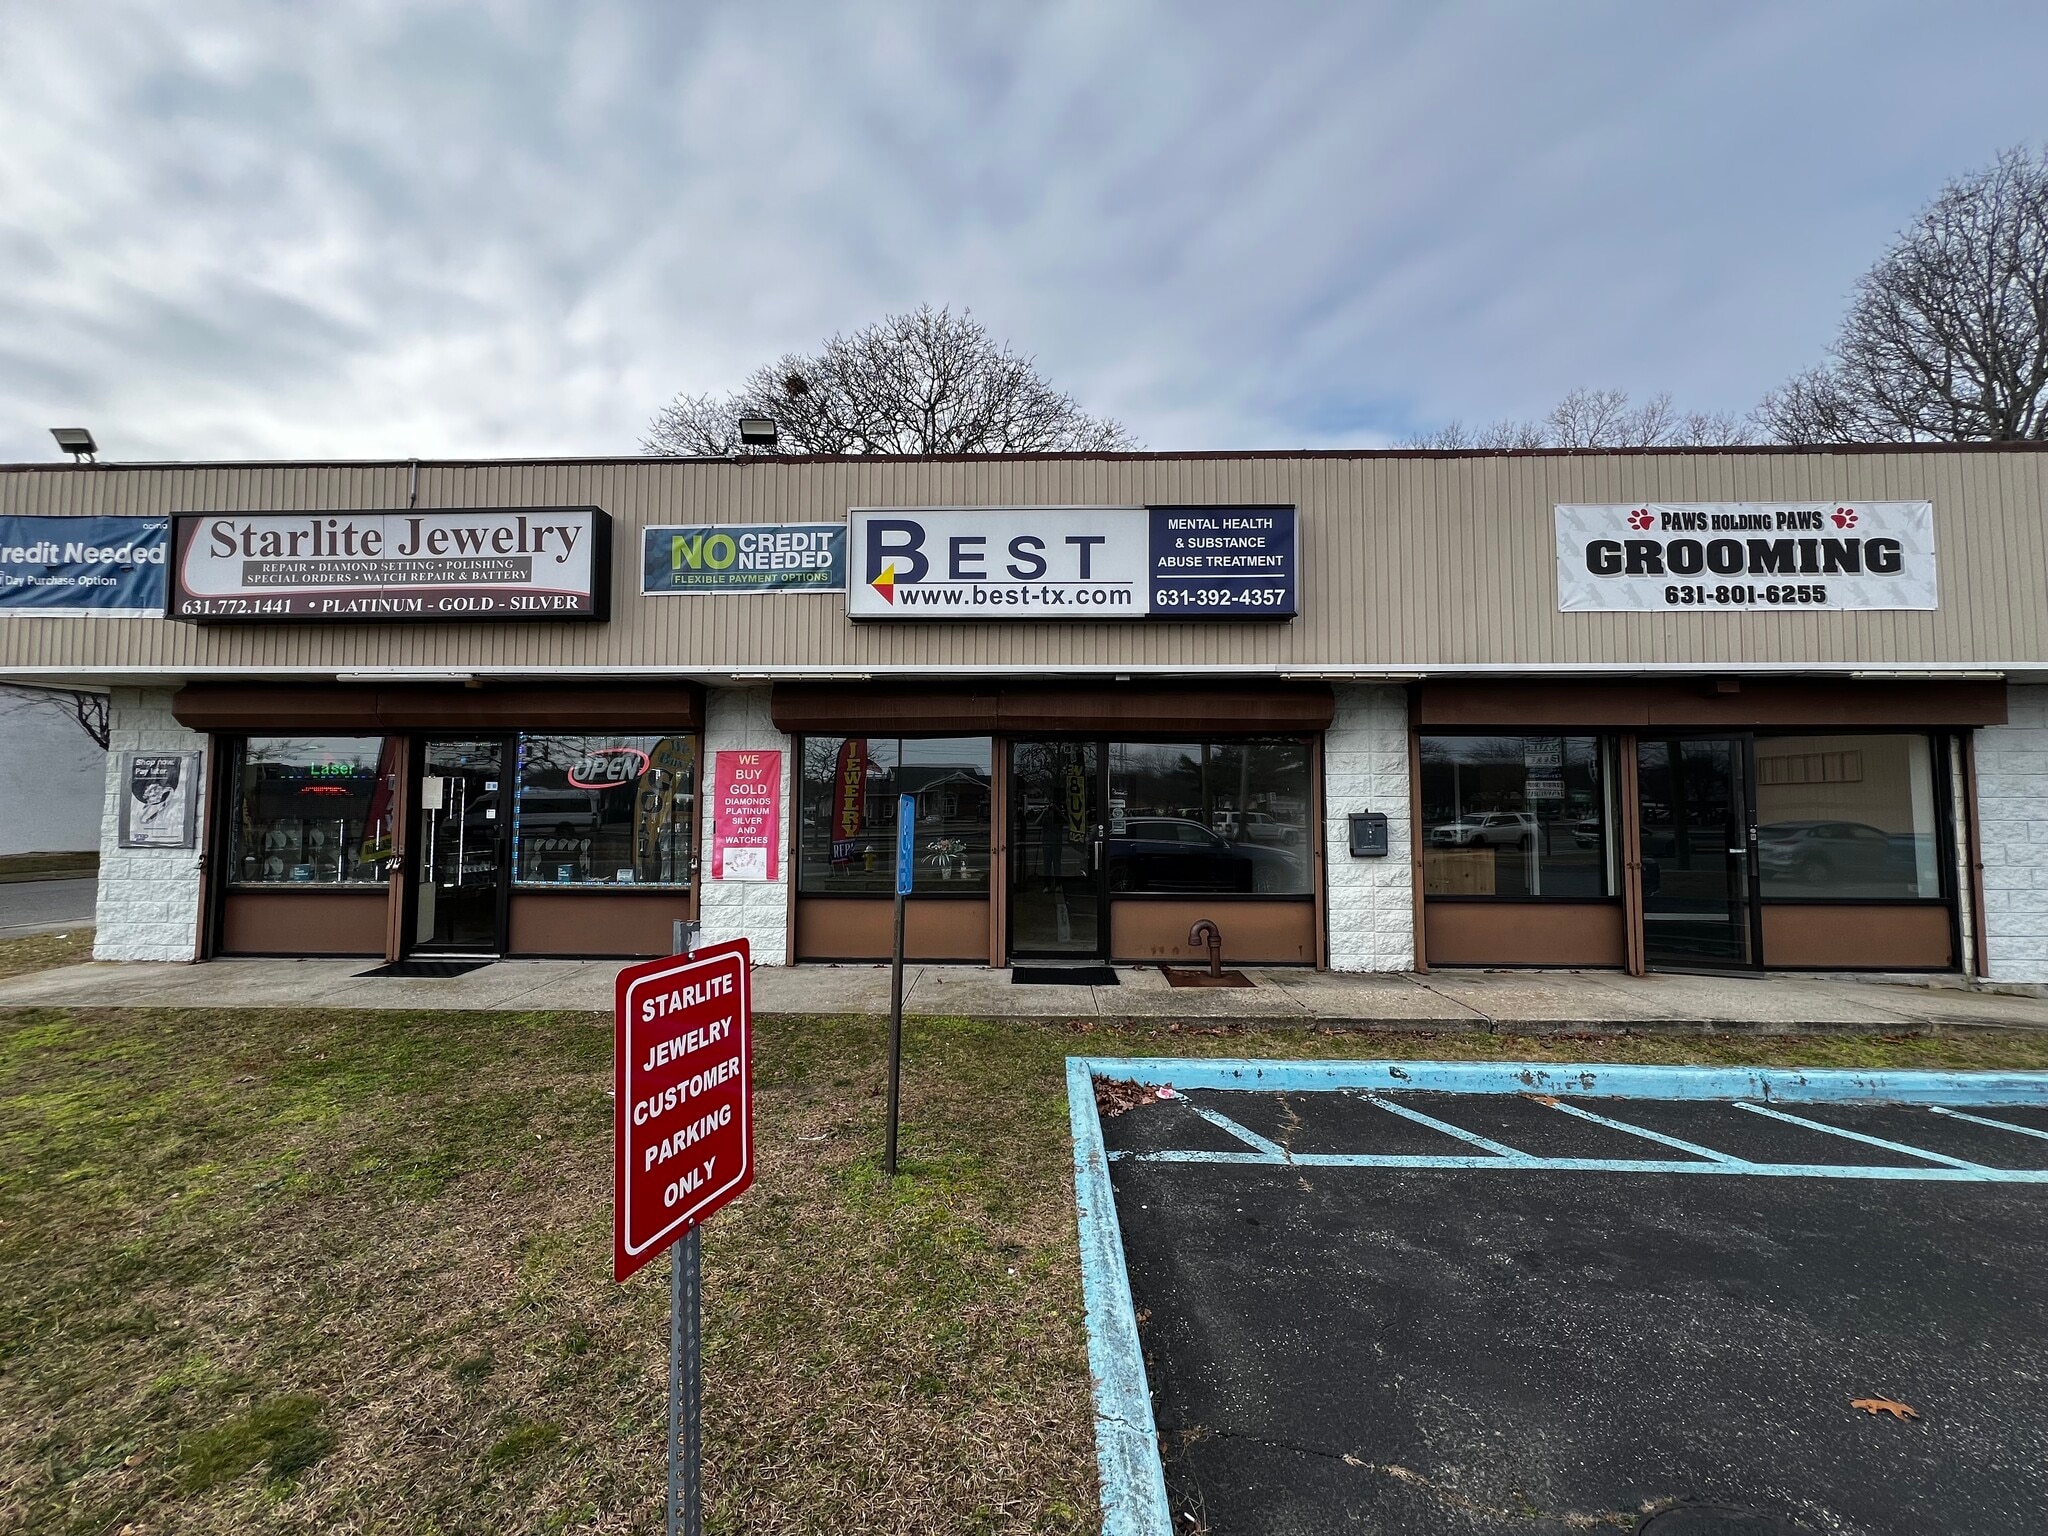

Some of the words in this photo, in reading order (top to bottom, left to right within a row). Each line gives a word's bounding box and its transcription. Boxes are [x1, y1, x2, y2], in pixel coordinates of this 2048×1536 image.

[1168, 519, 1220, 530] MENTAL
[1223, 518, 1273, 529] HEALTH
[1661, 512, 1708, 531] PAWS
[1711, 514, 1771, 531] HOLDING
[1776, 511, 1823, 531] PAWS
[210, 519, 383, 559] Starlite
[397, 516, 583, 564] Jewelry
[738, 532, 834, 553] CREDIT
[1175, 538, 1184, 548] &
[1187, 537, 1266, 548] SUBSTANCE
[0, 541, 60, 564] redit
[63, 542, 167, 564] Needed
[671, 534, 736, 570] NO
[738, 551, 833, 570] NEEDED
[866, 519, 1106, 585] BEST
[1158, 556, 1203, 567] ABUSE
[1206, 555, 1284, 567] TREATMENT
[1585, 537, 1903, 576] GROOMING
[262, 563, 307, 572] REPAIR
[318, 562, 378, 572] DIAMOND
[381, 561, 435, 571] SETTING
[446, 559, 514, 569] POLISHING
[5, 575, 24, 587] Day
[27, 575, 75, 586] Purchase
[78, 575, 117, 587] Option
[247, 574, 299, 583] SPECIAL
[302, 573, 352, 583] ORDERS
[363, 573, 406, 582] WATCH
[410, 572, 455, 581] REPAIR
[458, 571, 468, 580] &
[472, 570, 528, 580] BATTERY
[674, 575, 726, 584] FLEXIBLE
[729, 574, 778, 583] PAYMENT
[781, 573, 828, 582] OPTIONS
[900, 585, 1132, 605] www.best-tx.com
[1156, 589, 1286, 606] 631-392-4357
[1664, 585, 1827, 605] 631-801-6255
[181, 599, 292, 615] 631.772.1441
[321, 599, 423, 613] PLATINUM
[438, 597, 494, 611] GOLD
[509, 595, 579, 610] SILVER
[310, 762, 354, 775] Laser
[572, 755, 641, 781] OPEN
[738, 754, 760, 765] WE
[735, 769, 763, 780] BUY
[729, 784, 767, 795] GOLD
[841, 742, 861, 838] JEWELRY
[724, 797, 771, 806] DIAMONDS
[725, 807, 770, 815] PLATINUM
[732, 817, 763, 825] SILVER
[725, 836, 768, 844] WATCHES
[641, 973, 733, 1023] STARLITE
[643, 1015, 733, 1072] JEWELRY
[633, 1056, 740, 1126] CUSTOMER
[645, 1104, 731, 1172] PARKING
[663, 1156, 717, 1208] ONLY
